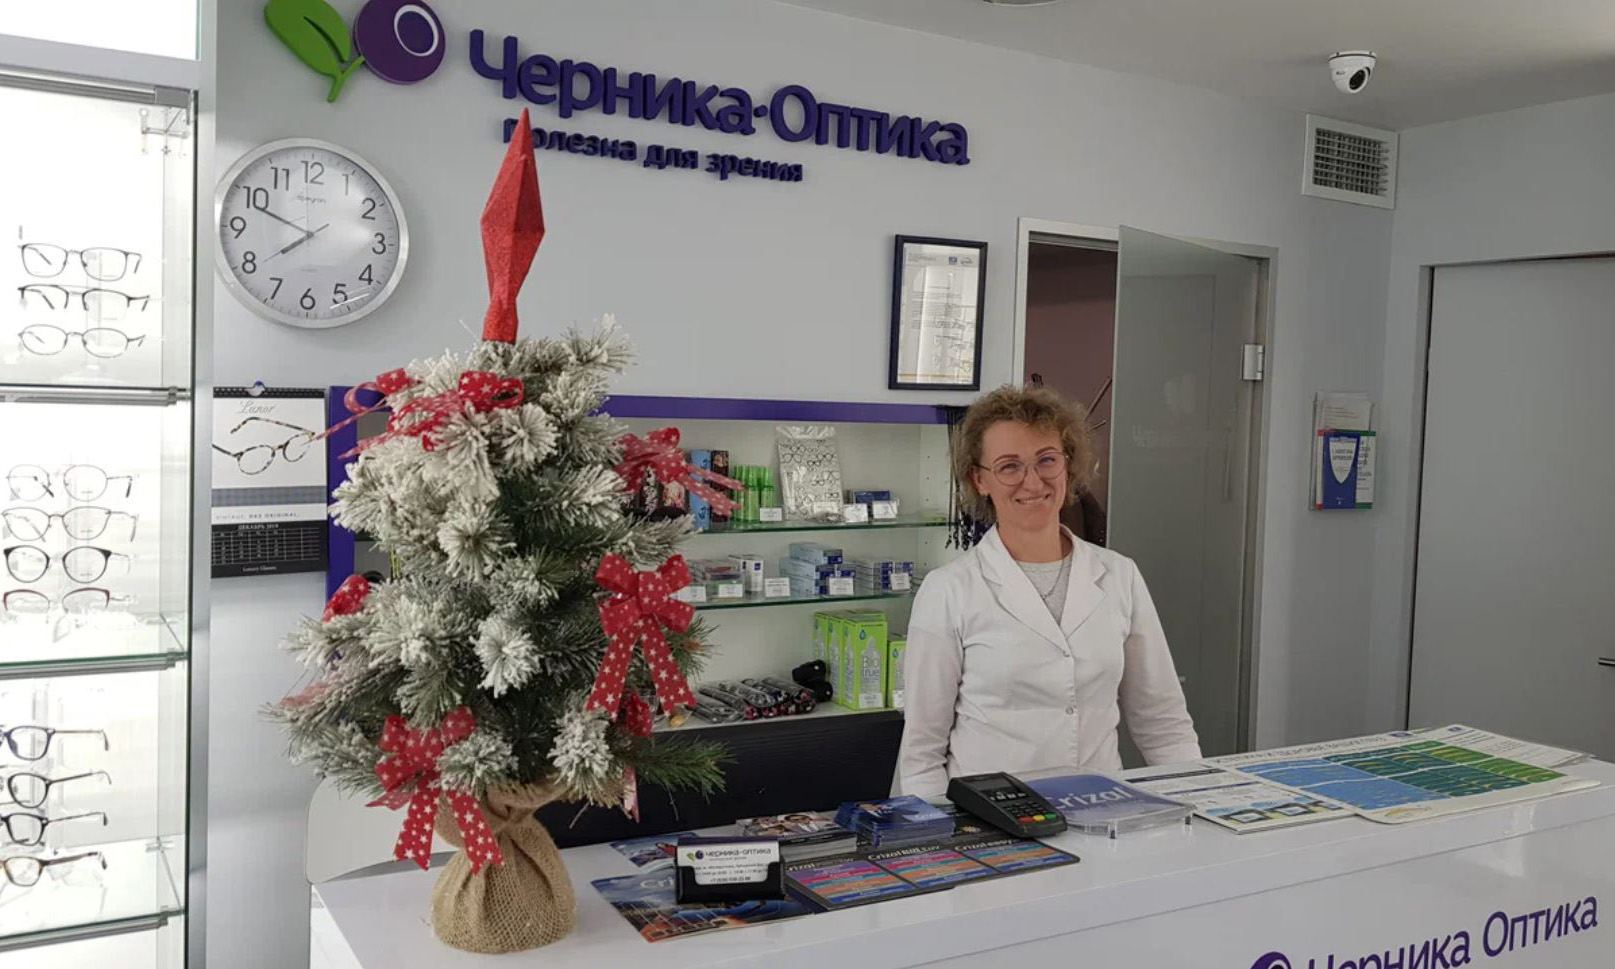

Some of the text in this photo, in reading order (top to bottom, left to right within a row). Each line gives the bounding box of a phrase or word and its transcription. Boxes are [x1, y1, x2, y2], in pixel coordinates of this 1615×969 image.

[300, 160, 324, 186] 12
[643, 143, 698, 171] для
[705, 150, 803, 181] зрения
[271, 166, 290, 191] 11
[342, 173, 350, 196] 1
[243, 185, 270, 211] 10
[361, 197, 376, 221] 2
[230, 216, 247, 239] 9
[372, 232, 387, 255] 3
[241, 251, 257, 274] 8
[358, 263, 374, 286] 4
[269, 277, 283, 300] 7
[300, 287, 316, 311] 6
[332, 282, 348, 305] 5
[1483, 896, 1598, 957] Оптика
